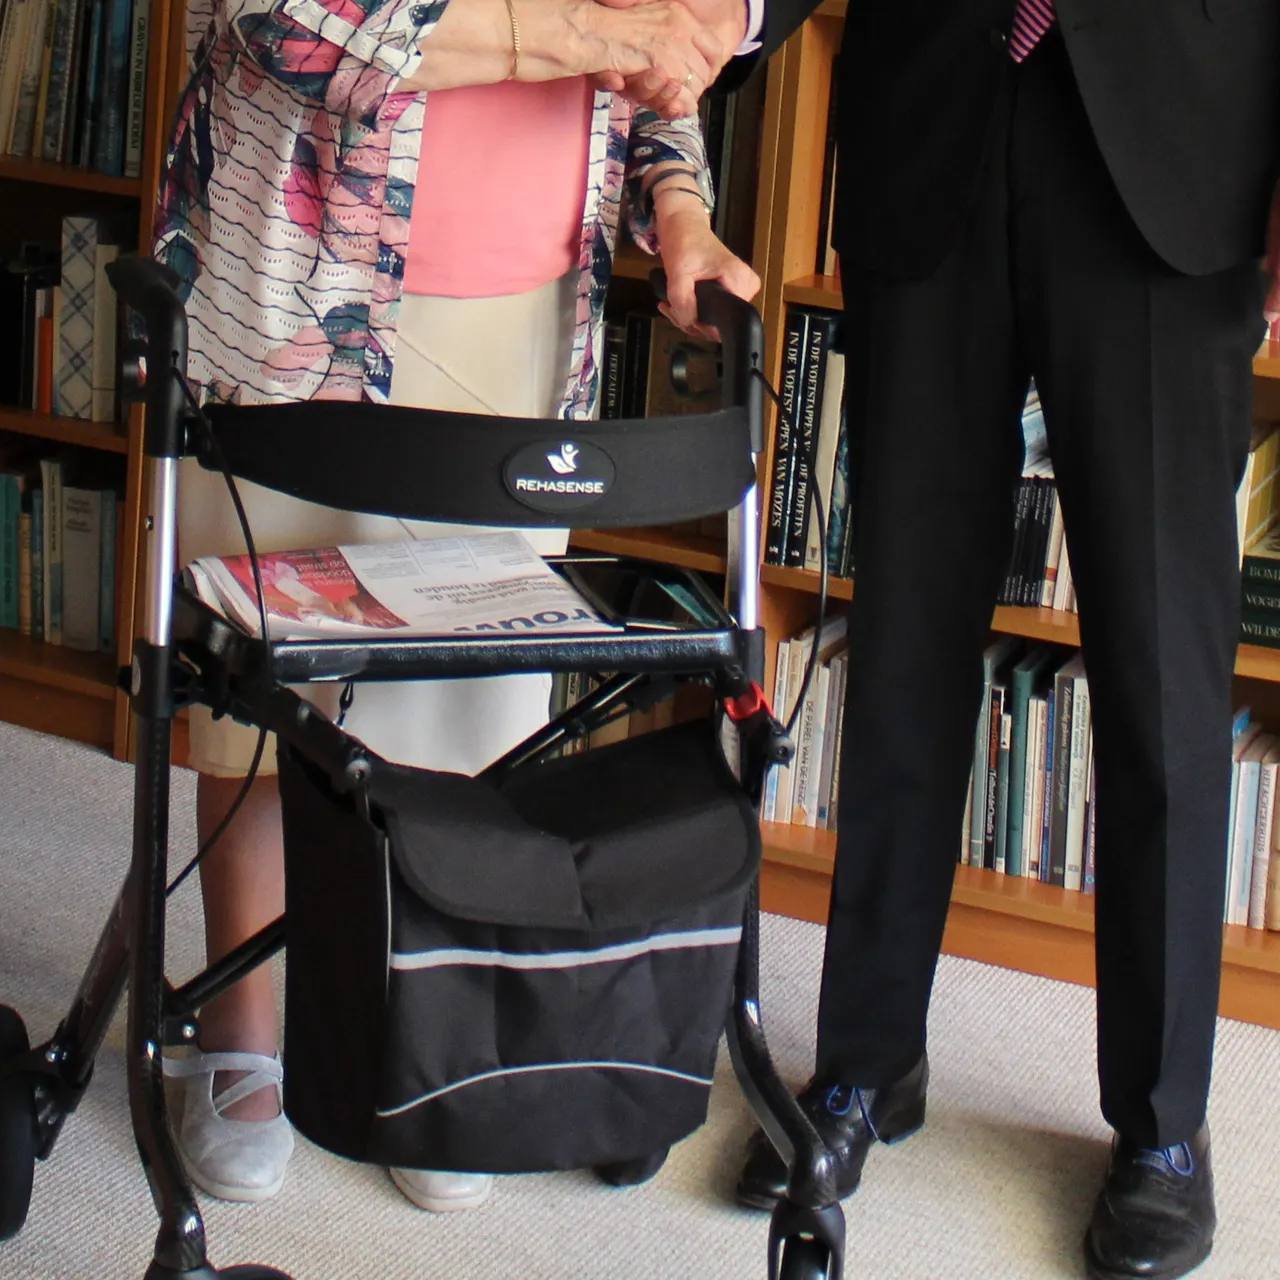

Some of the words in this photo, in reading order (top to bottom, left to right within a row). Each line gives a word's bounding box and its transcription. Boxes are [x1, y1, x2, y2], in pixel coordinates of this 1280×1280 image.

[790, 331, 800, 346] IN
[813, 331, 822, 344] IN
[787, 348, 798, 364] DE
[811, 347, 820, 362] DE
[804, 364, 819, 438] VOETSTAPPEN
[779, 369, 796, 451] VOETSTPPEN
[777, 458, 787, 481] VAN
[799, 463, 808, 479] DE
[516, 479, 604, 494] REHASENSE
[772, 485, 784, 527] MOZES
[794, 481, 807, 537] PROFETEN
[413, 582, 471, 595] houden
[453, 608, 595, 632] rou
[1241, 622, 1280, 638] WILDE
[805, 700, 814, 711] DE
